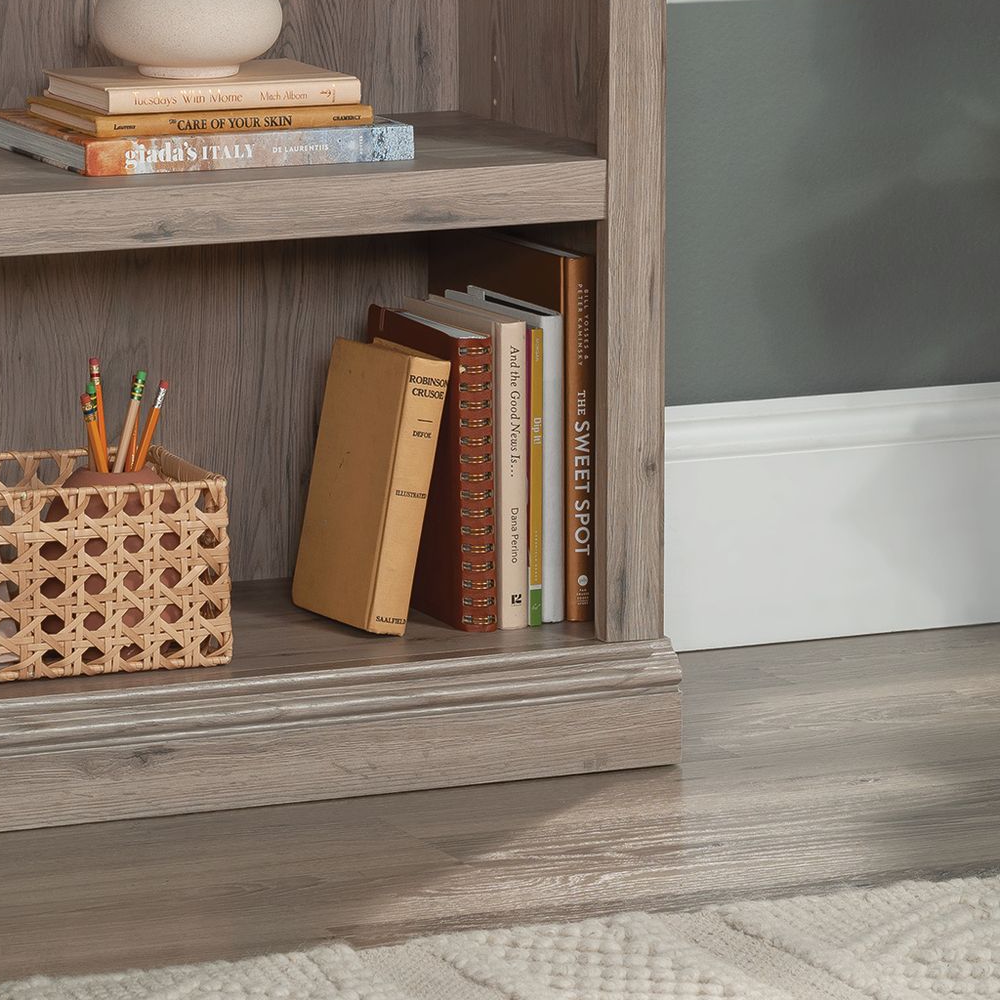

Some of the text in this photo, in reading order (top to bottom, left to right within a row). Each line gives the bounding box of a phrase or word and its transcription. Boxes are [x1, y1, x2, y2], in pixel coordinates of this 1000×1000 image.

[132, 91, 177, 107] Tuesdays
[180, 88, 206, 104] With
[260, 89, 281, 101] Mitch
[177, 119, 208, 131] CARE
[210, 118, 226, 129] OF
[228, 117, 262, 129] YOUR
[264, 115, 293, 127] SKIN
[125, 141, 256, 169] giada's ITALY
[285, 144, 329, 153] LAURENTIIS
[510, 345, 520, 368] And
[510, 370, 521, 387] the
[412, 387, 444, 400] CRUSOE
[510, 390, 521, 420] Good
[532, 417, 541, 432] Dip
[412, 430, 432, 439] DEFOE
[510, 422, 521, 452] News
[574, 391, 590, 556] THE SWEET SPOT
[511, 507, 520, 564] Dana Perino
